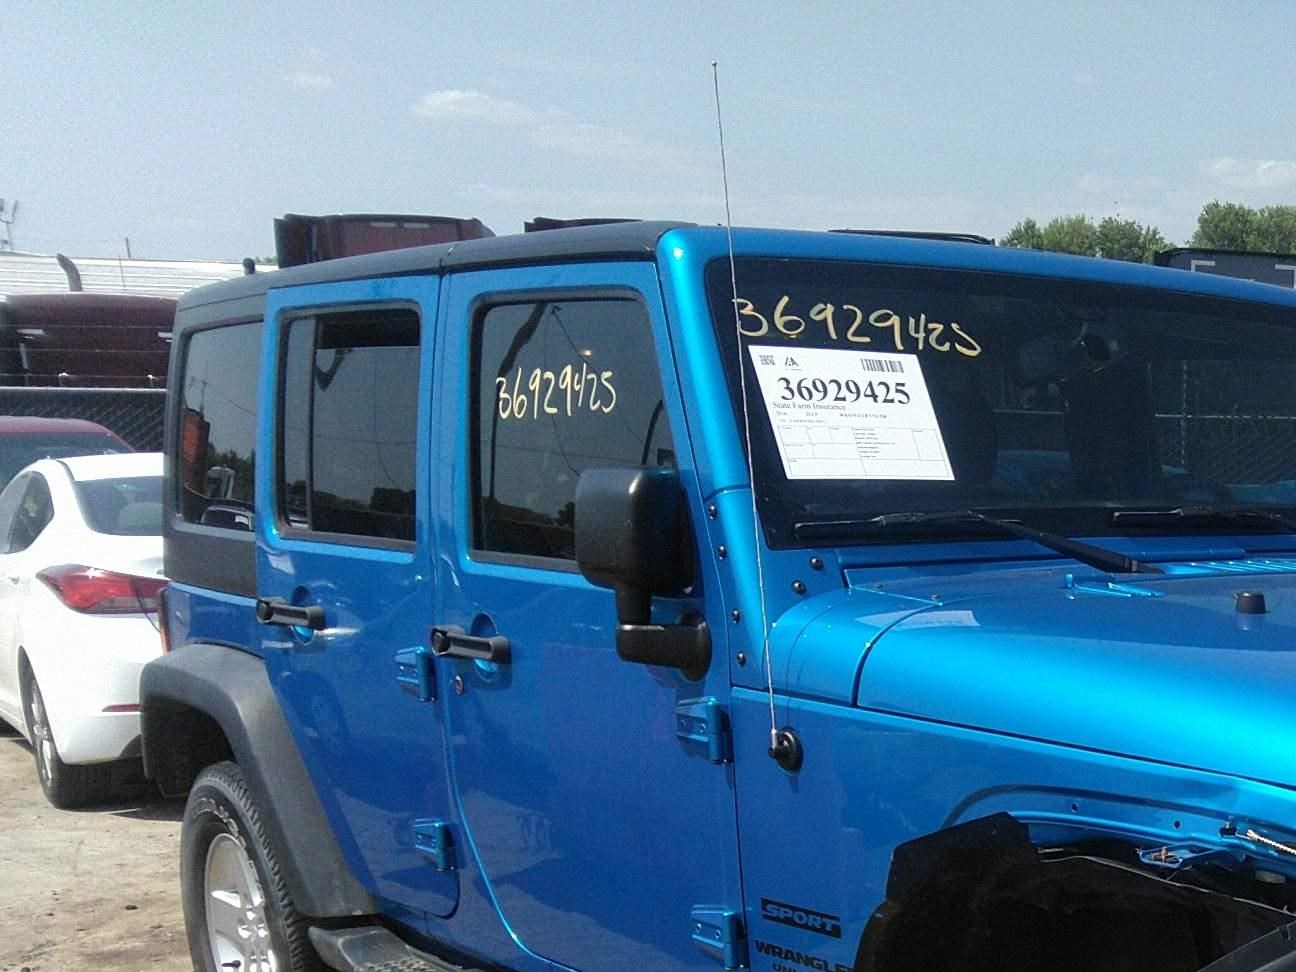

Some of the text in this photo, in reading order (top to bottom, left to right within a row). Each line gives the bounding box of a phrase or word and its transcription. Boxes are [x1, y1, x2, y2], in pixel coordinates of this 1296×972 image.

[731, 295, 982, 357] 36929425
[495, 363, 617, 420] 36929425
[777, 377, 911, 405] 36929425
[765, 903, 841, 932] SPORT
